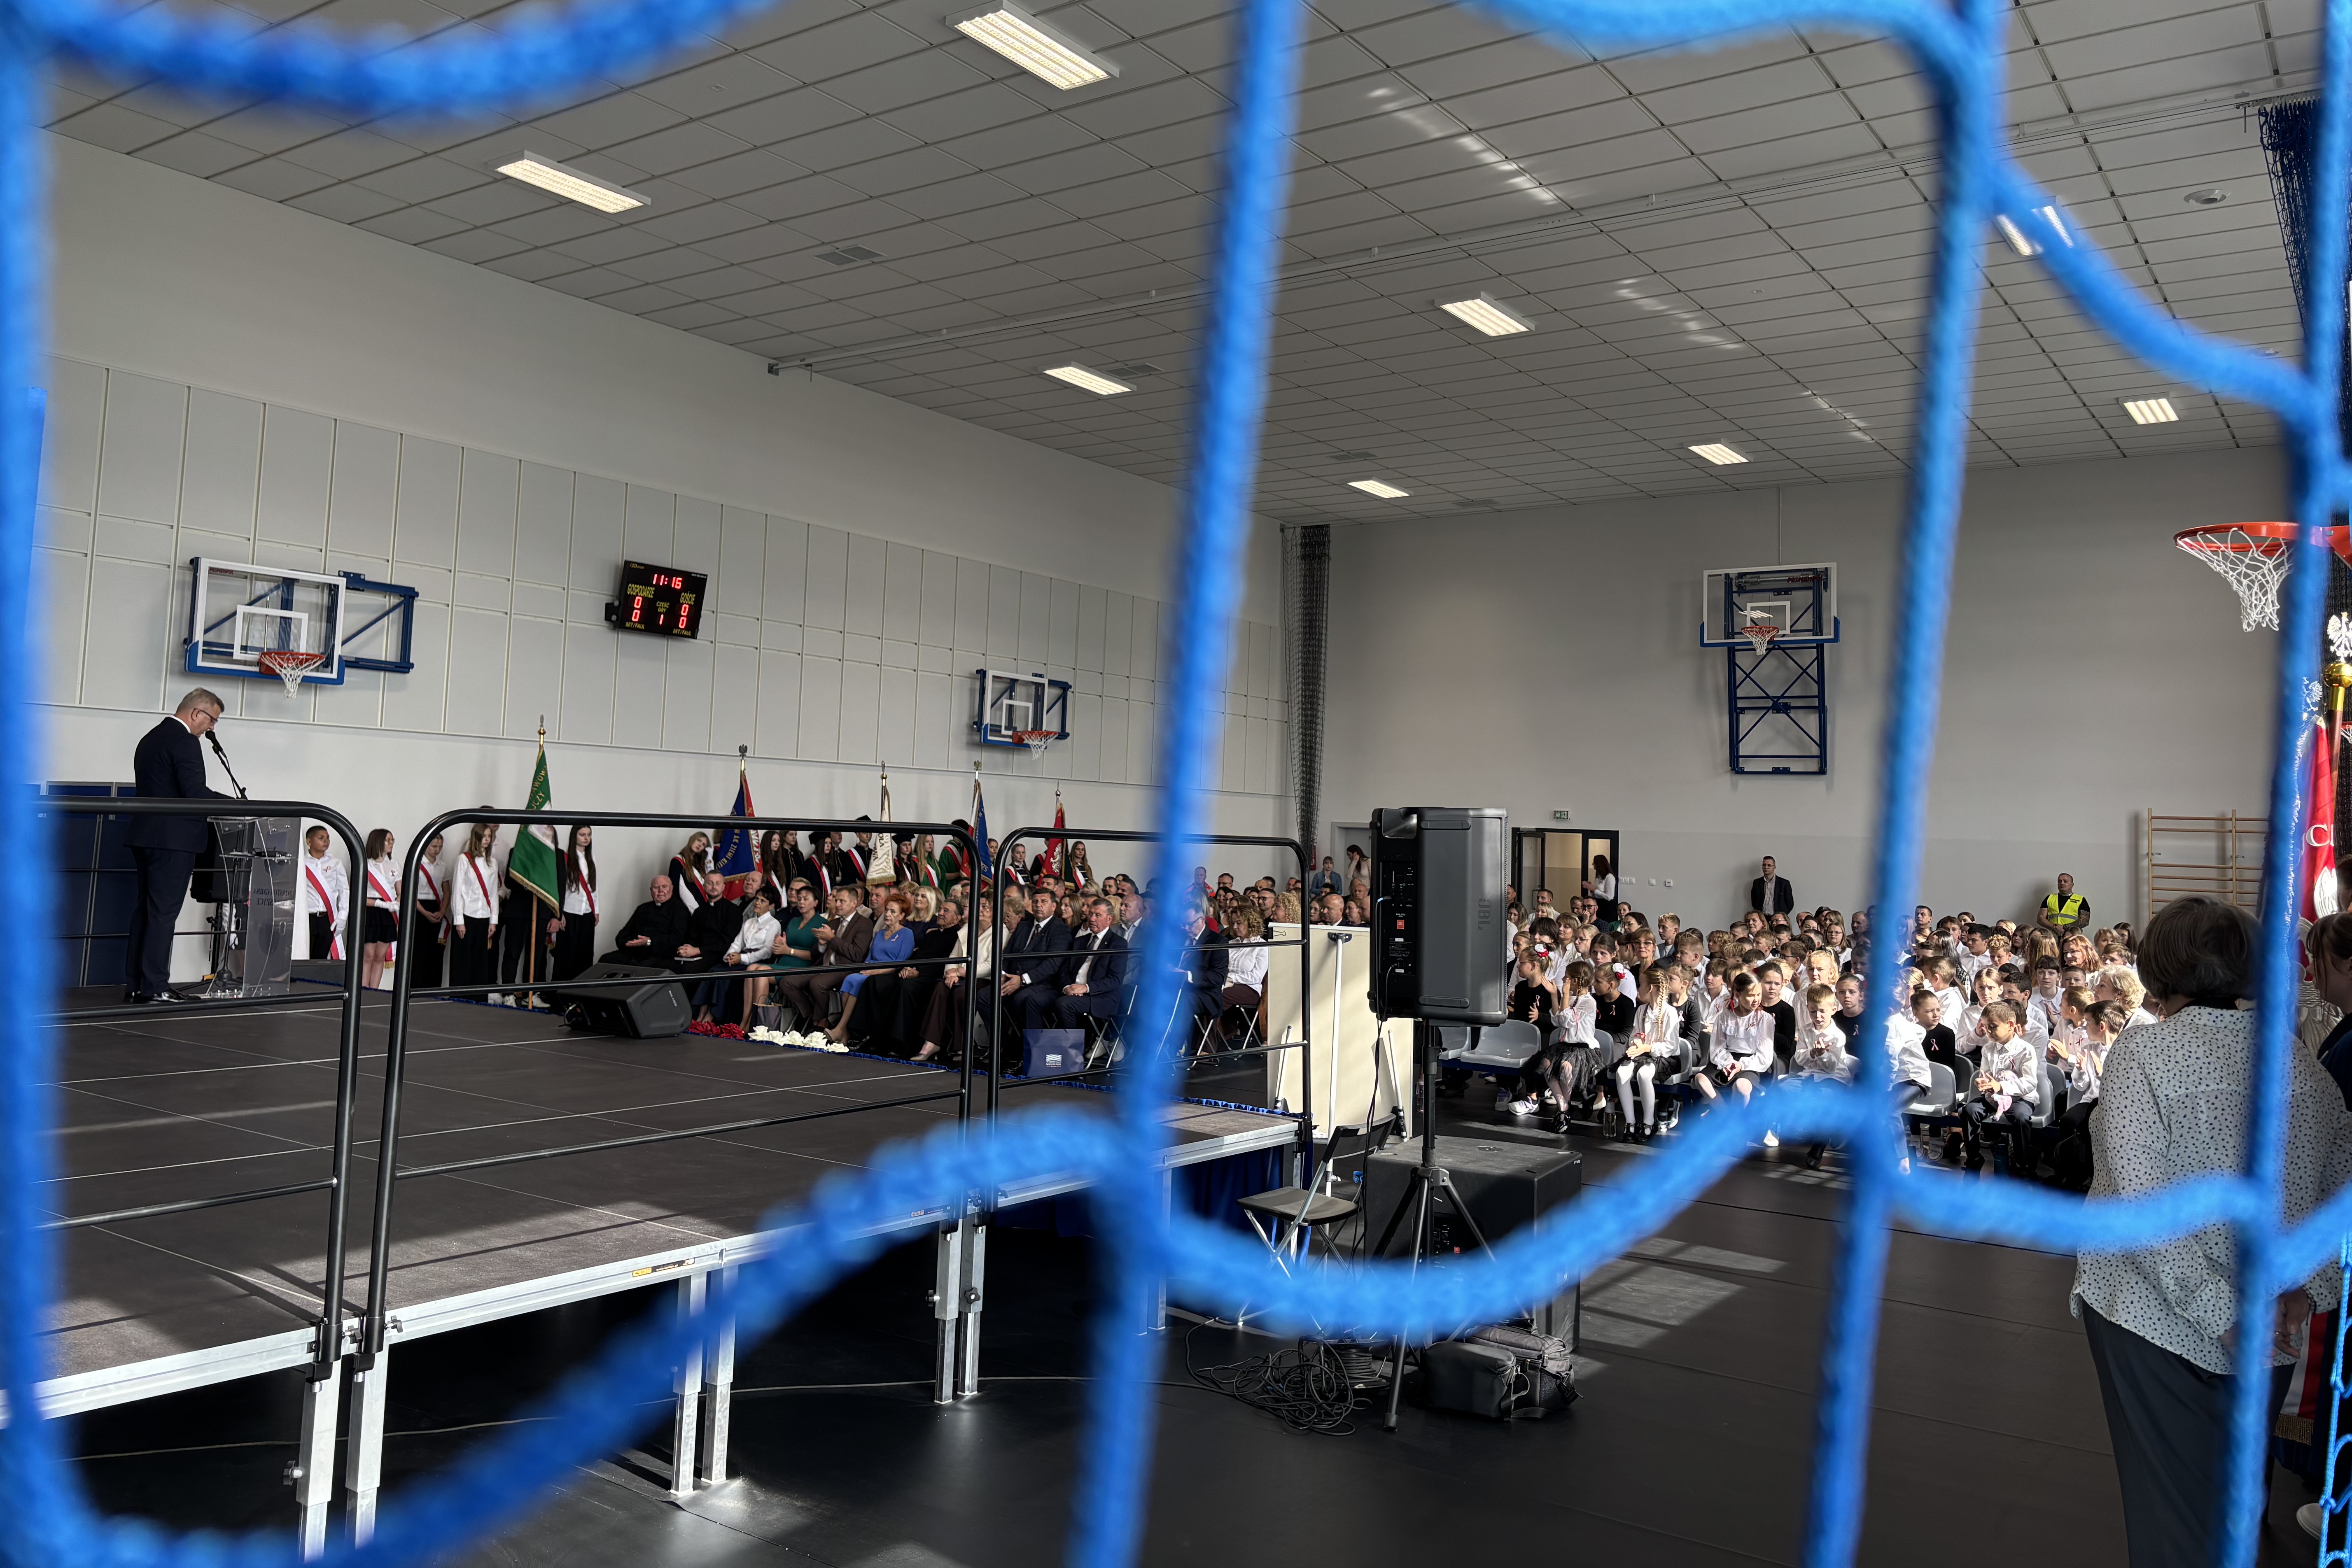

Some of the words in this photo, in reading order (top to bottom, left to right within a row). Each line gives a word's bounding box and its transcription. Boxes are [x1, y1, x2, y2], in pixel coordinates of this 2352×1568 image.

[653, 574, 682, 589] 11:16
[627, 583, 655, 598] GOSPODARZE
[634, 596, 642, 608] 0
[680, 591, 696, 605] GOŚCIE
[632, 610, 640, 622] 0
[681, 604, 689, 616] 0
[659, 614, 664, 625] 1
[679, 617, 686, 629] 0
[726, 843, 737, 860] ZIEMI
[1478, 899, 1490, 930] JBL
